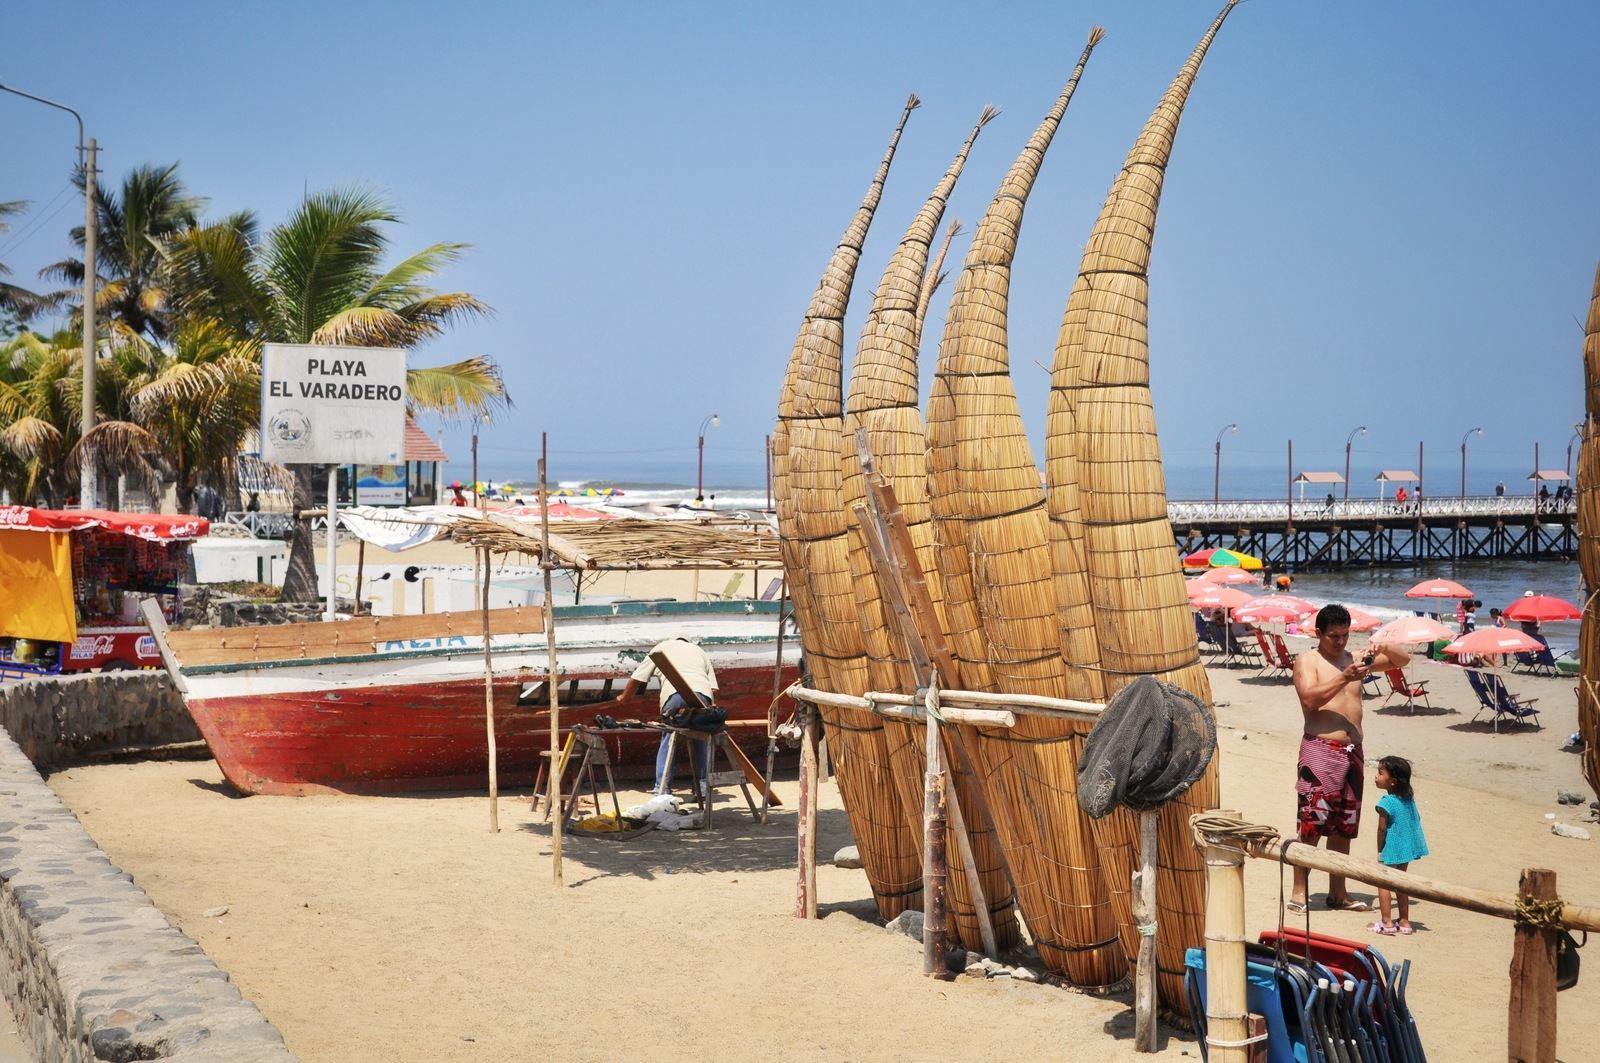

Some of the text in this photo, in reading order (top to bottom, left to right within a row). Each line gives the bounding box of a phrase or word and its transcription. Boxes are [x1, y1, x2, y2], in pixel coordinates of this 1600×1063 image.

[308, 359, 367, 377] PLAYA
[270, 381, 402, 401] EL VARADERO
